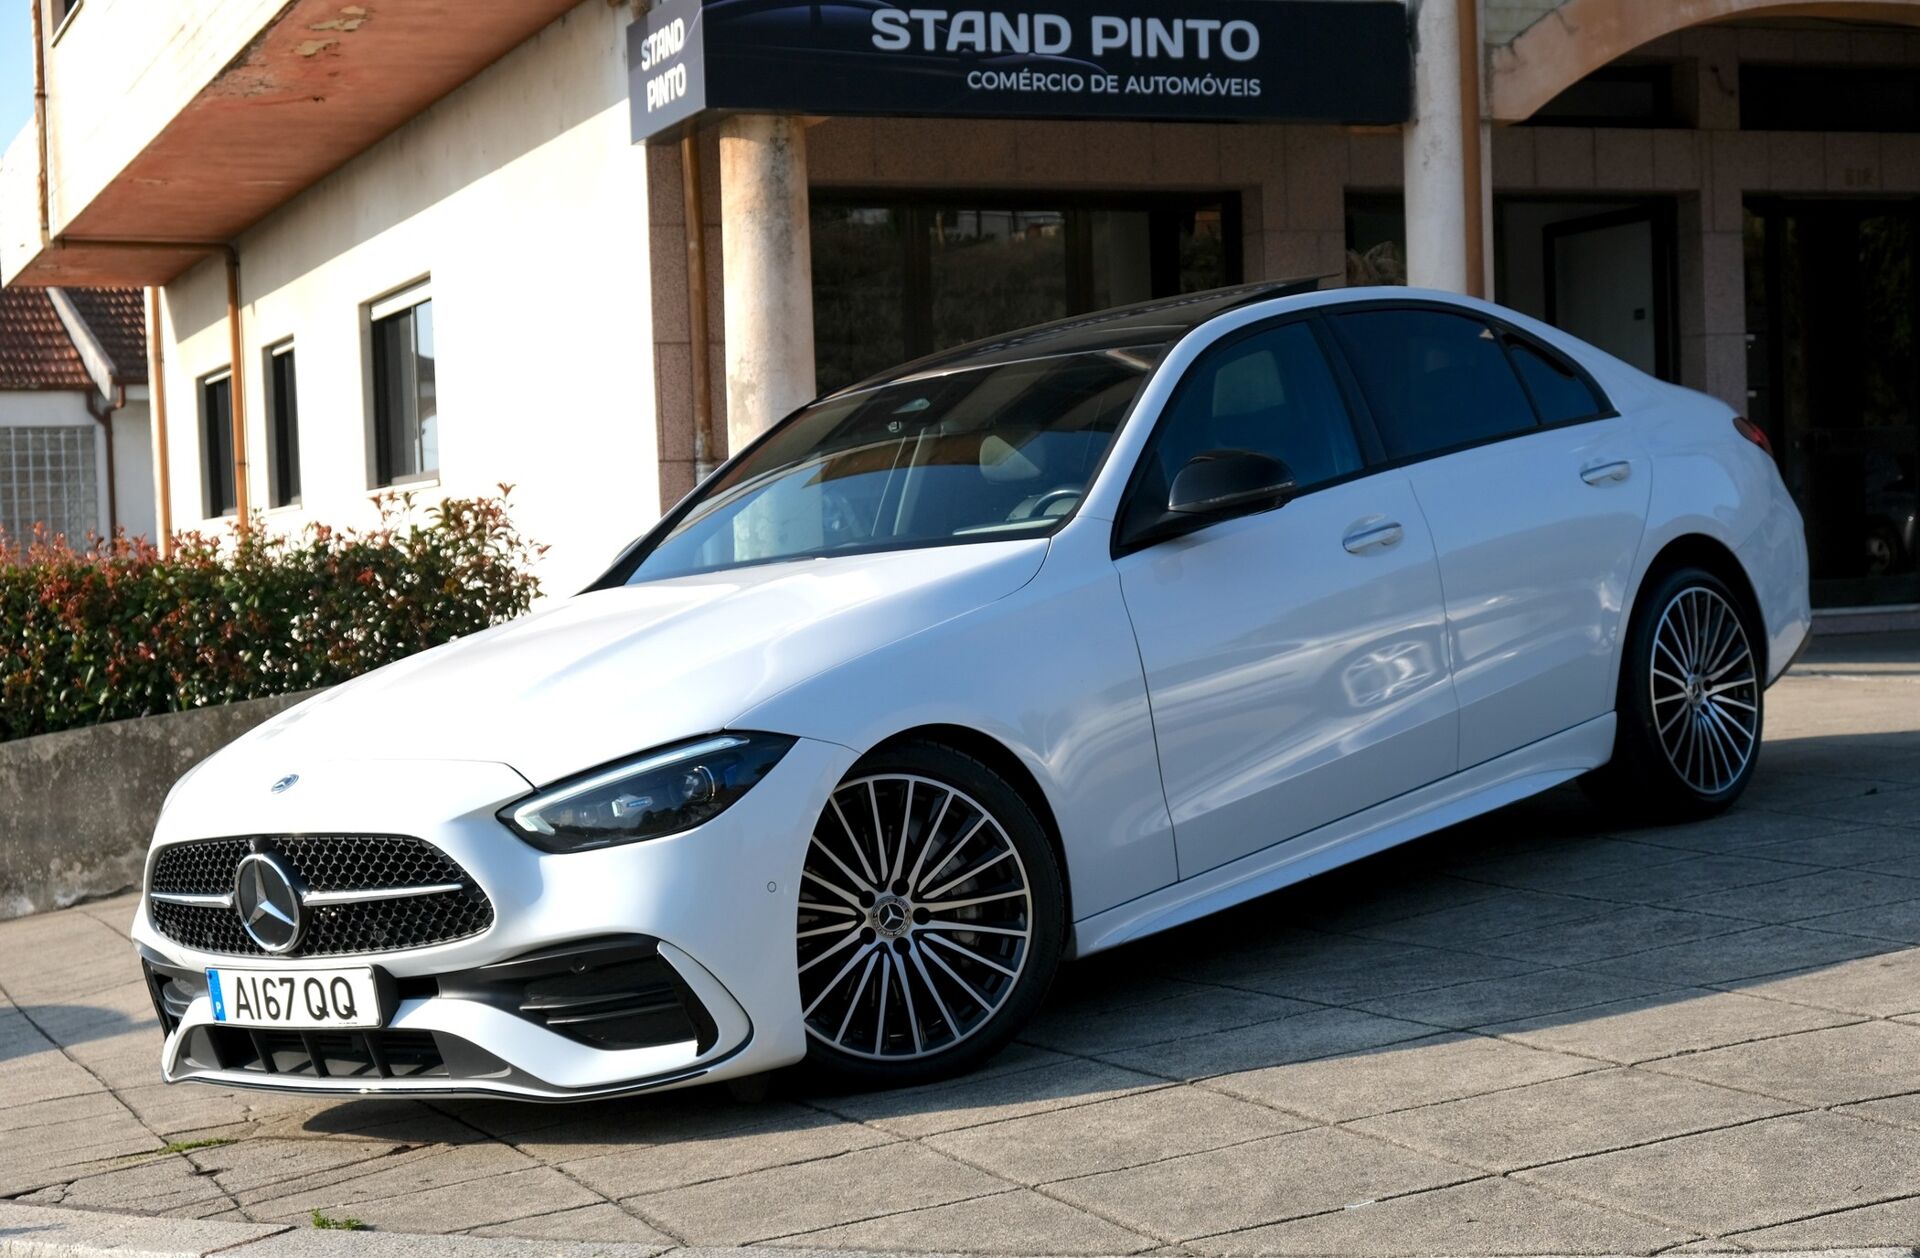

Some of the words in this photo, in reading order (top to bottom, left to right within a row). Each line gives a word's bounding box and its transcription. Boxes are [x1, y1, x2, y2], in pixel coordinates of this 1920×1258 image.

[641, 18, 685, 71] STAND
[871, 8, 1072, 54] STAND
[1091, 15, 1260, 61] PINTO
[647, 63, 686, 113] PINTO
[967, 68, 1083, 92] COMÉRCIO
[1091, 74, 1119, 93] DE
[1125, 73, 1261, 96] AUTOMÓVEIS
[214, 1001, 222, 1013] P
[304, 976, 358, 1021] QQ
